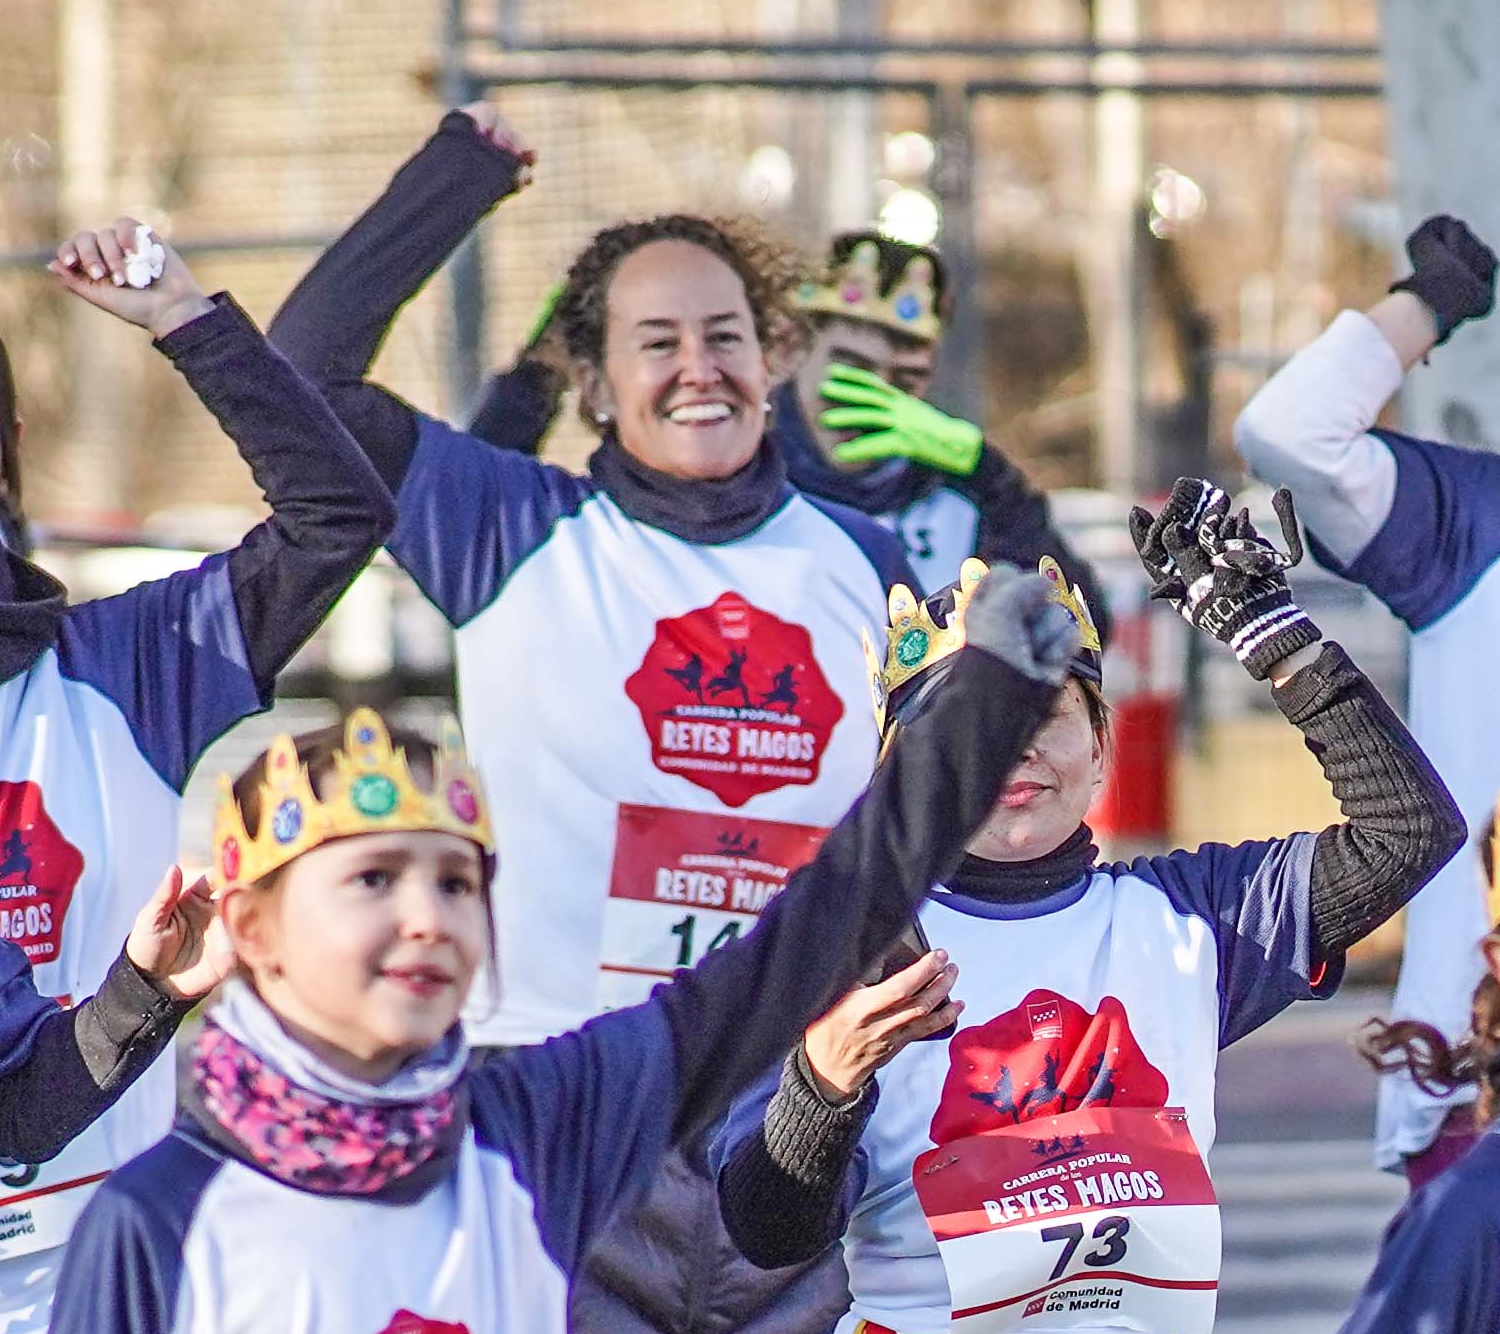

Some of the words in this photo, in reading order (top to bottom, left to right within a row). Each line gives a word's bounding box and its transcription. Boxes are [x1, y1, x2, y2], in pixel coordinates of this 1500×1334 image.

[660, 720, 731, 755] REYES
[737, 727, 815, 762] MAGOS
[654, 867, 727, 907] REYES
[1003, 1165, 1065, 1191] CARRERA
[1068, 1152, 1132, 1171] POPULAR
[982, 1184, 1069, 1225] REYES
[1073, 1170, 1164, 1208] MAGOS
[1040, 1215, 1131, 1282] 73
[1046, 1300, 1064, 1312] de
[1068, 1298, 1120, 1312] Madrid
[1049, 1286, 1124, 1300] Comunidad
